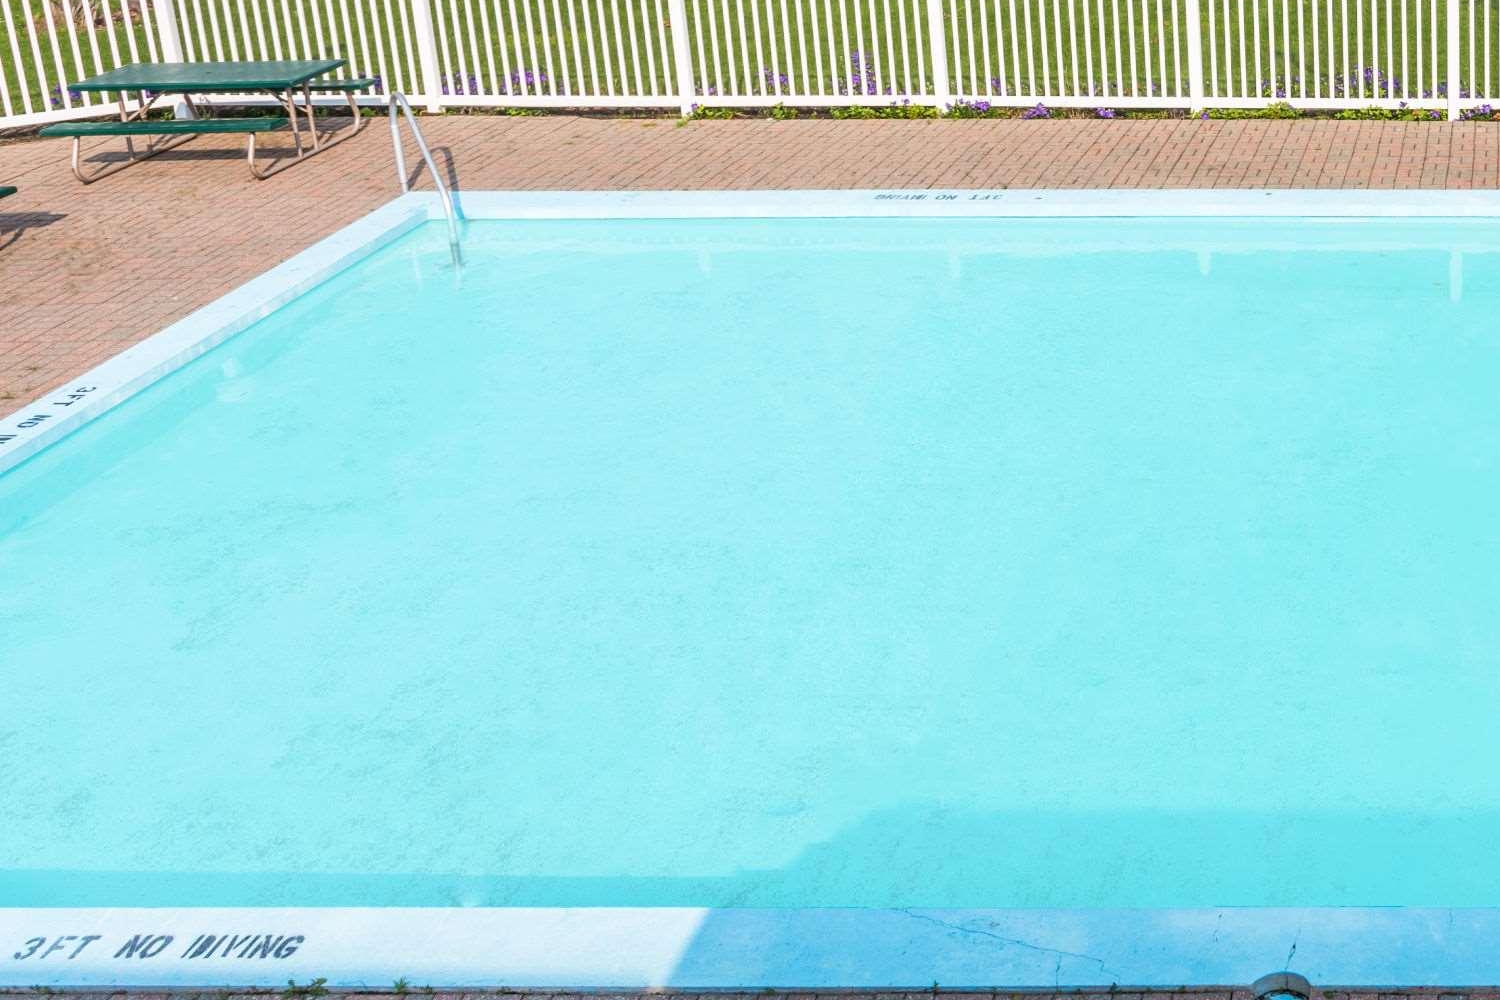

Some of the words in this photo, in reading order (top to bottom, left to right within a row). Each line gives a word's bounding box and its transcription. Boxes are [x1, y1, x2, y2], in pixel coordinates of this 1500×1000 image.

[52, 386, 97, 406] 3FT
[17, 414, 52, 428] NO
[13, 935, 102, 960] 3FT
[113, 934, 174, 959] NO
[180, 934, 305, 959] DIVING
